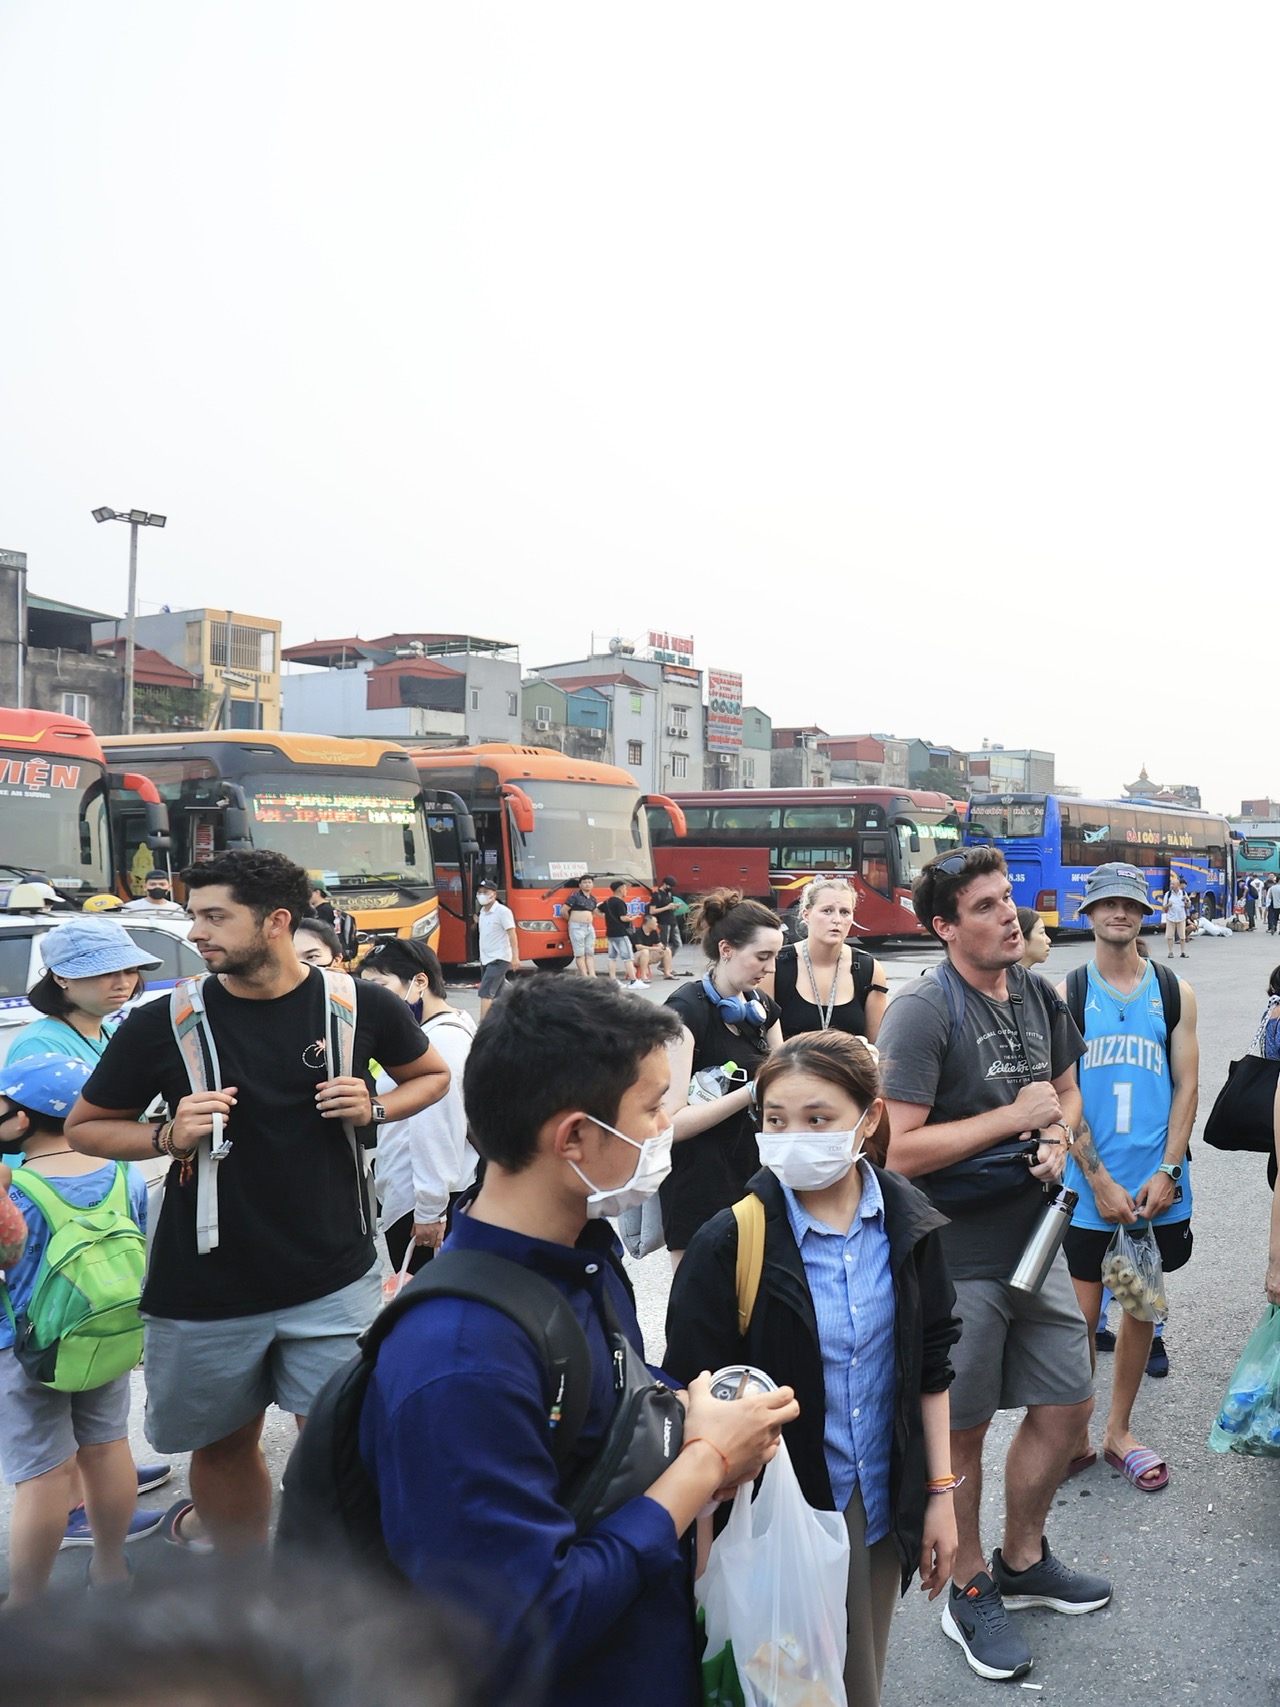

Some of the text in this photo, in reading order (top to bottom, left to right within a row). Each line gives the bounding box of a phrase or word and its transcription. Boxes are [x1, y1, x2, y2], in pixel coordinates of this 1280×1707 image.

[1126, 827, 1141, 844] SÀI
[1142, 829, 1160, 845] GÒN
[1167, 831, 1179, 846] HÀ
[1179, 832, 1193, 849] NỘI
[1083, 1033, 1163, 1077] BUZZCITY
[1112, 1082, 1133, 1135] 1
[663, 1416, 673, 1458] SPORT
